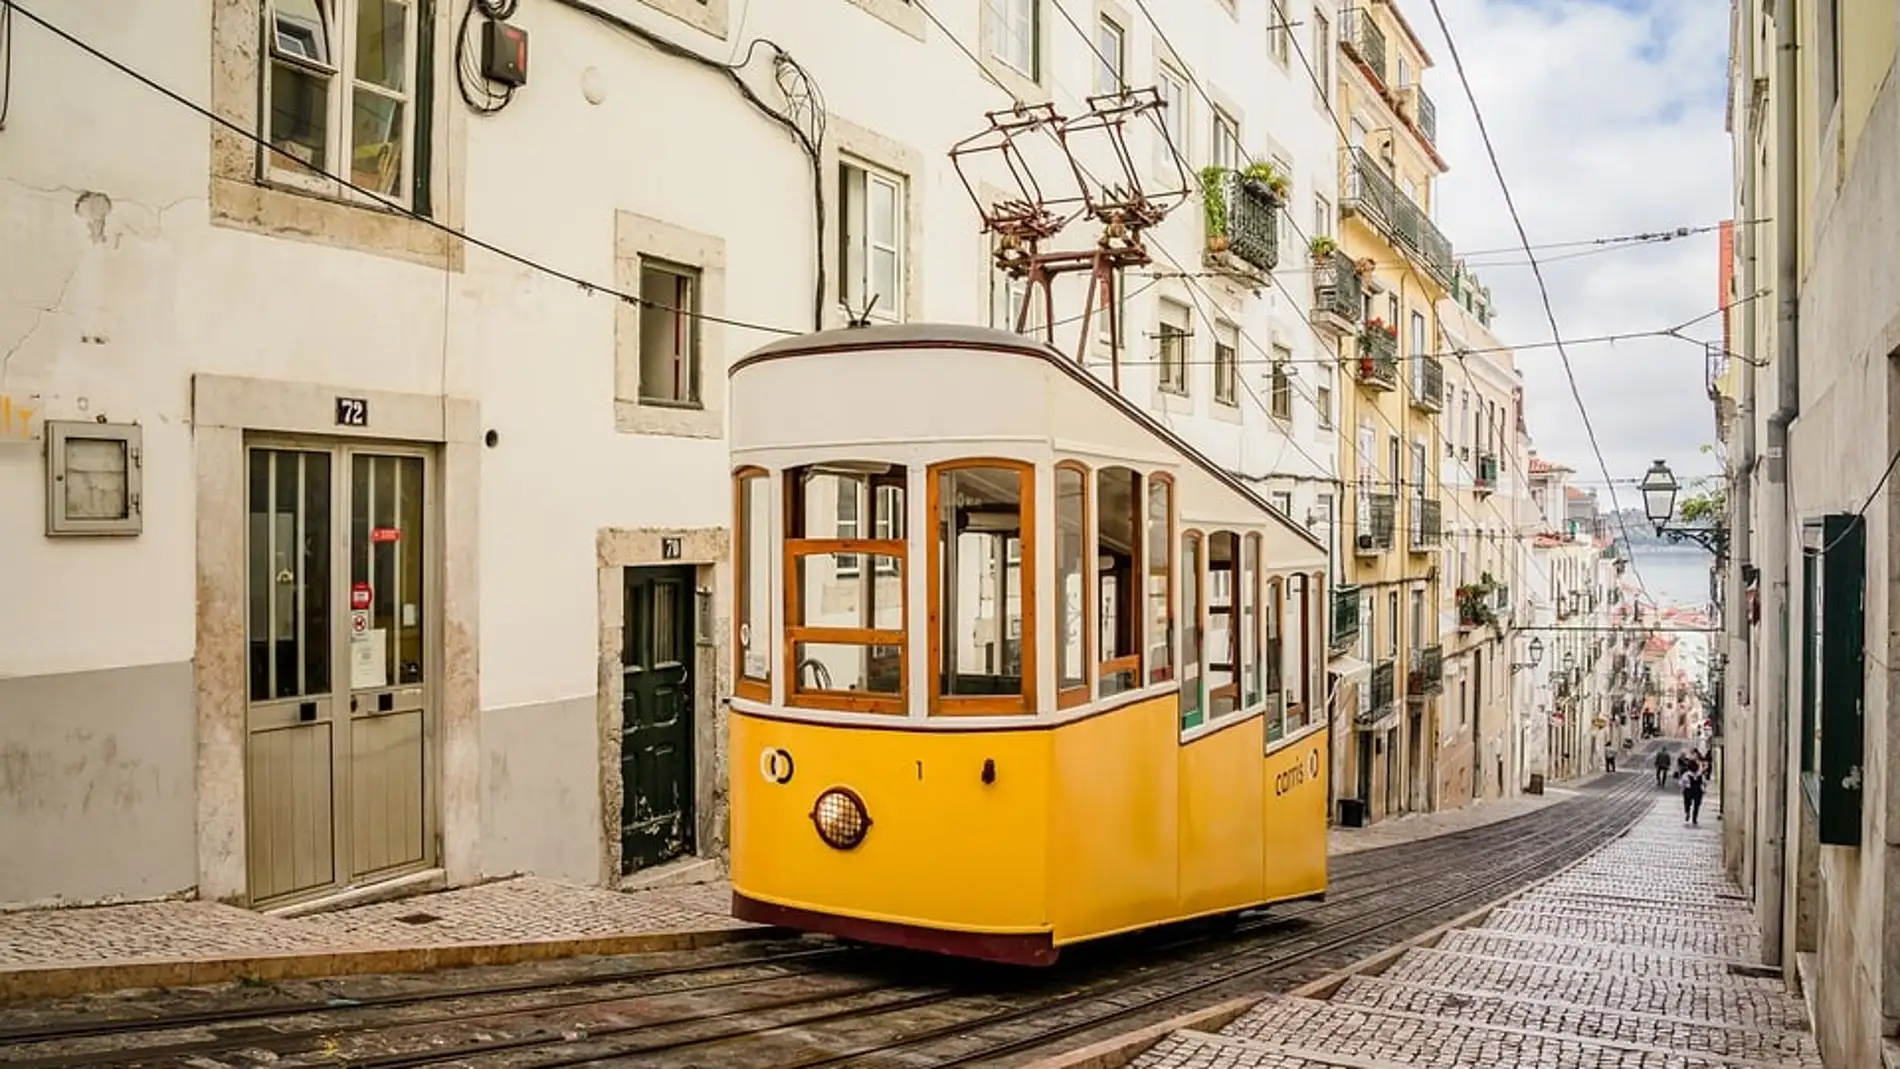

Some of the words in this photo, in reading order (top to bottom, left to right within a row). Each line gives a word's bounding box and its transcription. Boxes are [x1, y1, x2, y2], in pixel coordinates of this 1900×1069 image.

[341, 399, 364, 424] 72
[666, 539, 680, 557] 70
[915, 759, 923, 781] 1
